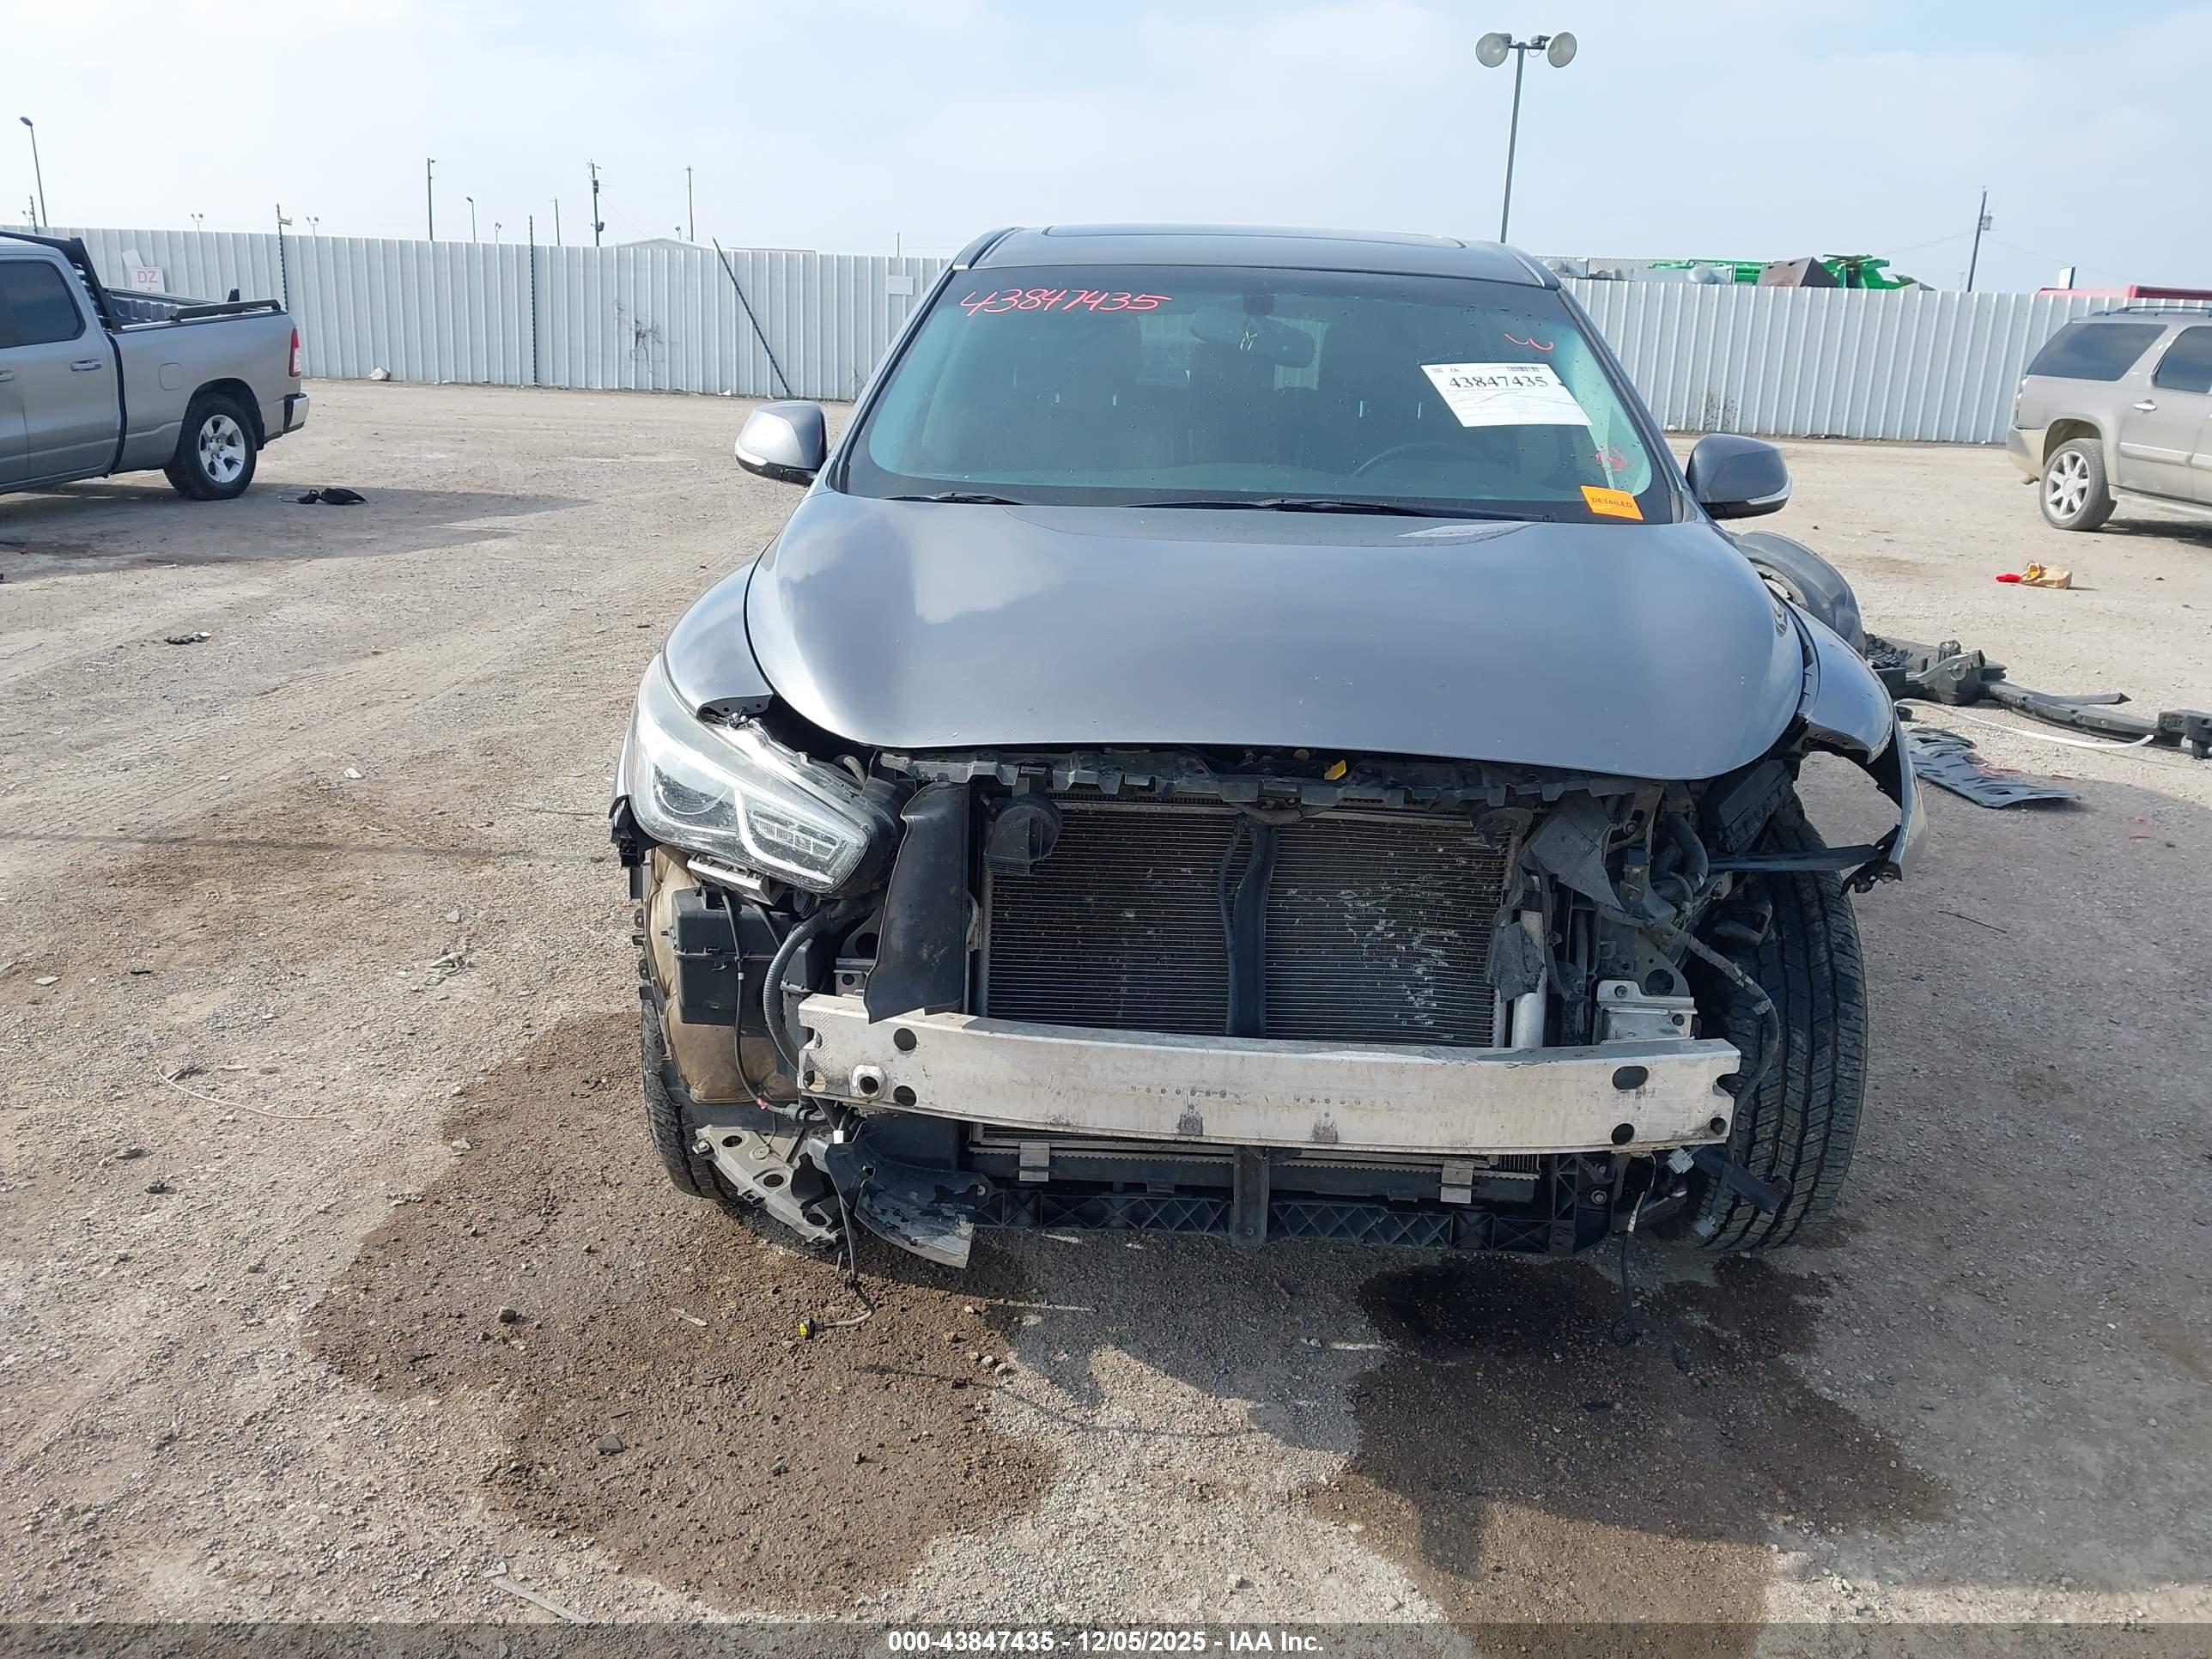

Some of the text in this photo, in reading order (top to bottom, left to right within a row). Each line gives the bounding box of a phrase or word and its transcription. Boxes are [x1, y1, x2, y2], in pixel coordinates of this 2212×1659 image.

[137, 270, 159, 283] DZ
[960, 289, 1173, 317] 43847435
[1449, 375, 1549, 388] 43847435
[1591, 496, 1634, 508] DETAILED
